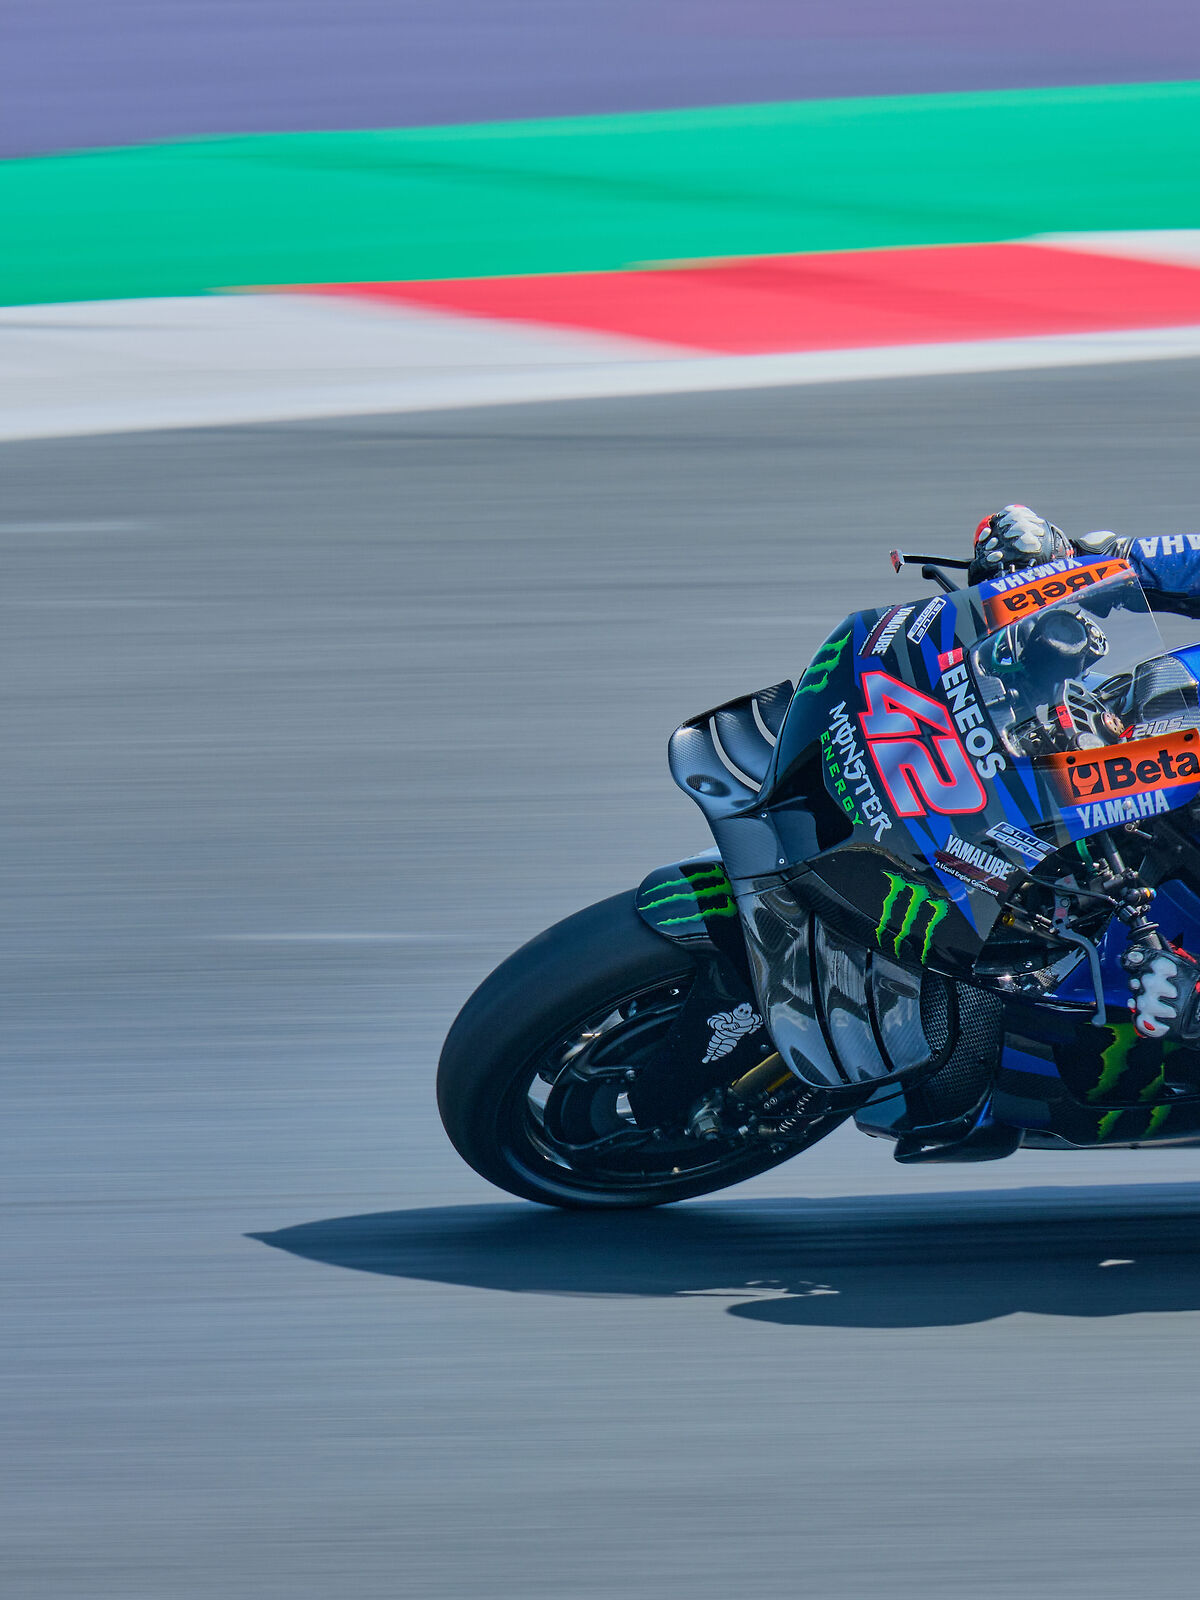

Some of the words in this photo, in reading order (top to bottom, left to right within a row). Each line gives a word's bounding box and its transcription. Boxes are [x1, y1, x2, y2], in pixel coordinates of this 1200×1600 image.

[990, 559, 1083, 593] YAMAHA
[1002, 572, 1096, 612] Beta
[872, 605, 916, 656] YAMALUBE
[941, 664, 1007, 779] ENEOS
[858, 670, 987, 817] 42
[820, 730, 864, 825] ENERGY
[829, 701, 892, 842] MONSTER
[1104, 750, 1200, 790] Beta
[1076, 789, 1170, 829] YAMAHA
[944, 834, 1013, 881] YAMALUBE
[994, 833, 1040, 857] CORE
[1002, 825, 1051, 852] BLUE
[971, 879, 1000, 897] Component
